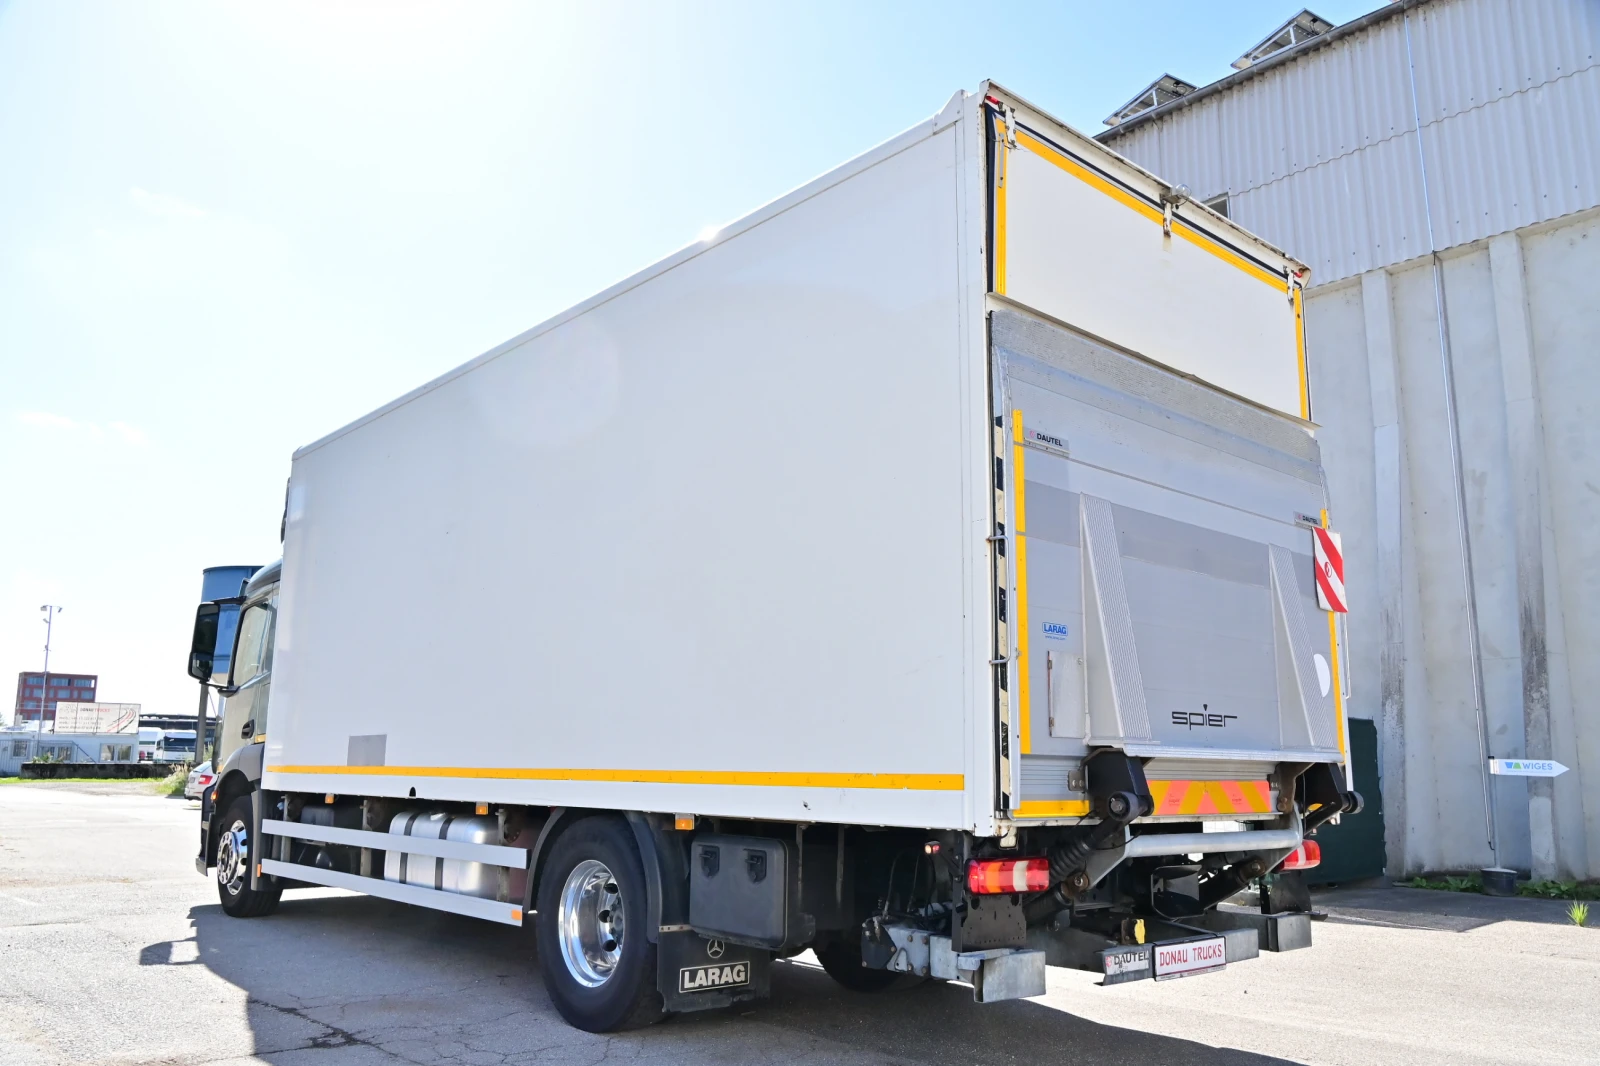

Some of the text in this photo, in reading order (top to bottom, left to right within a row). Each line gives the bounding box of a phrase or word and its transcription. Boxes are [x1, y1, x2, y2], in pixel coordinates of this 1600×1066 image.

[1036, 432, 1063, 447] DAUTEL
[1043, 623, 1067, 635] LARAG
[1171, 703, 1238, 731] spier
[1522, 762, 1553, 771] WIGES
[1113, 950, 1150, 966] DAUTEL
[1159, 943, 1223, 967] DONAU TRUCKS
[683, 964, 746, 989] LARAG
